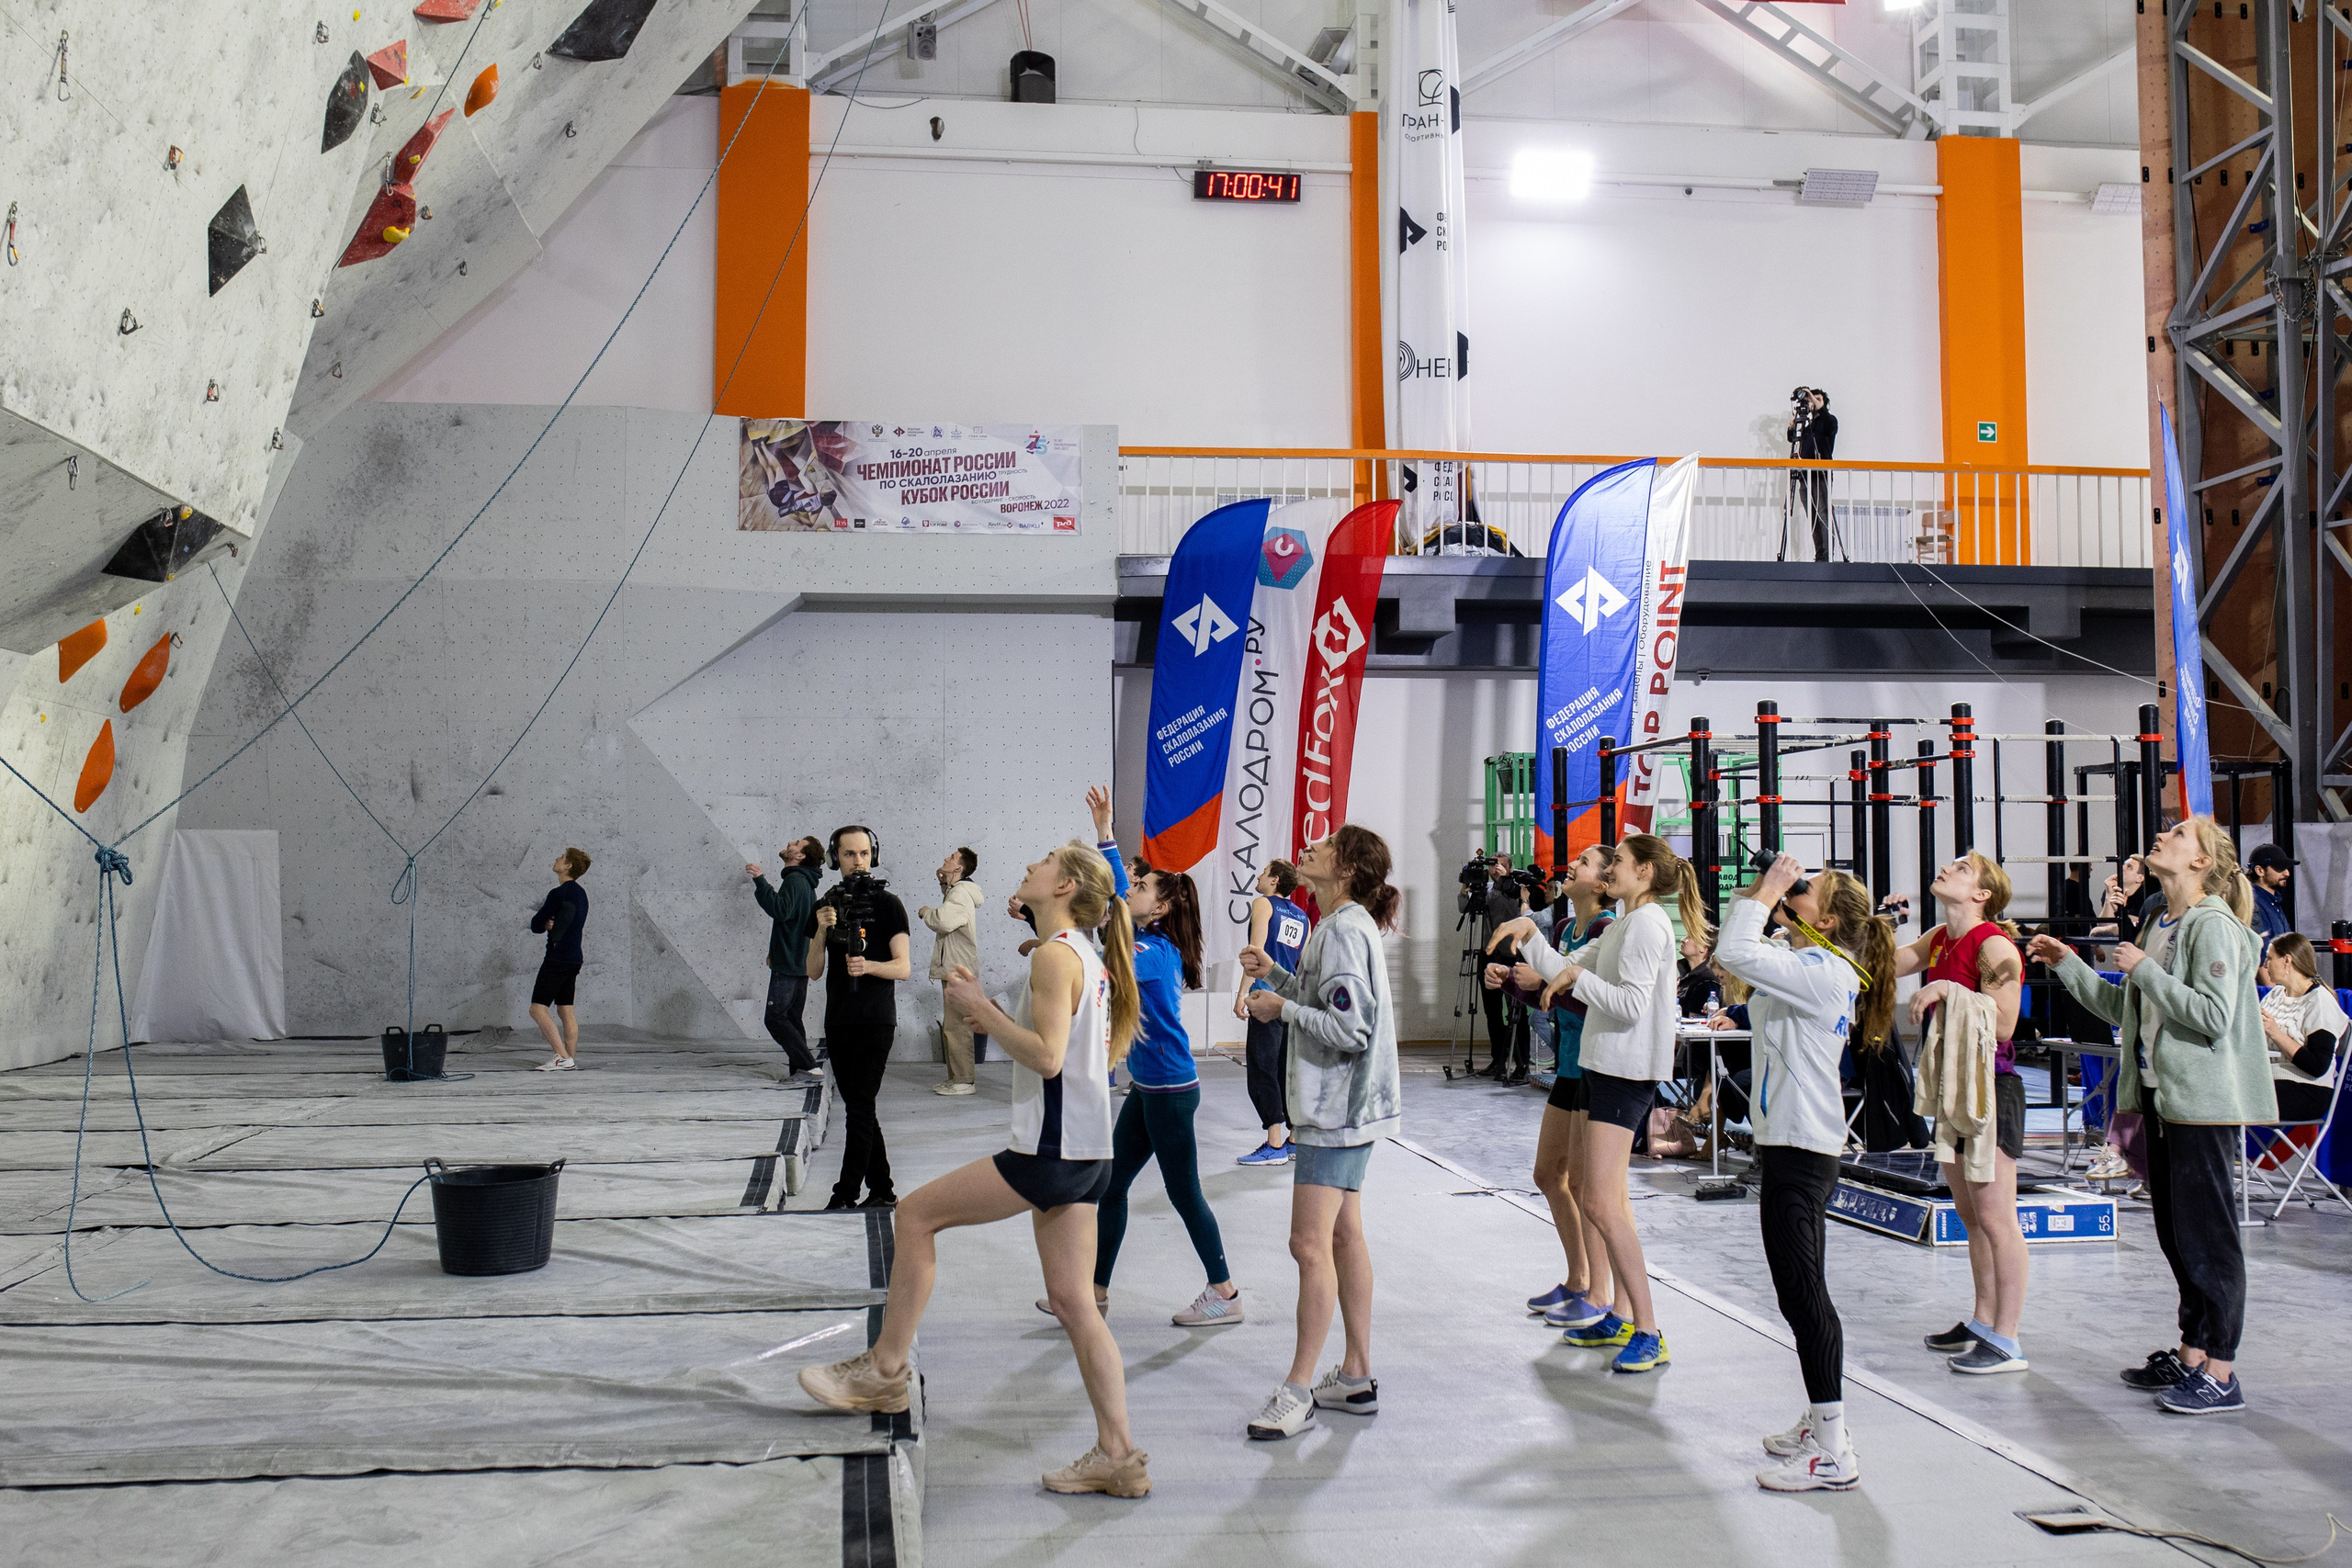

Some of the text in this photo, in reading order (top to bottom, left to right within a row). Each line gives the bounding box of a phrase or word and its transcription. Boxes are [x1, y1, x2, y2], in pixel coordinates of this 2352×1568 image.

[1208, 173, 1297, 199] 17:00:41
[856, 451, 1016, 481] ЧЕМПИОНАТ РОССИИ
[889, 447, 957, 459] 16-20 апреля
[879, 469, 998, 491] ПО СКАЛОЛАЗАНИЮ
[900, 481, 1011, 506] КУБОК РОССИИ
[1001, 498, 1069, 514] ВОРОНЕЖ 2022
[1638, 559, 1652, 650] Оборудование
[1634, 560, 1685, 796] TOP POINT
[1156, 705, 1206, 740] ФЕДЕРАЦИЯ
[1545, 686, 1600, 730] ФЕДЕРАЦИЯ
[1554, 688, 1624, 744] СКАЛОЛАЗАНИЯ
[1162, 707, 1228, 755] СКАЛОЛАЗАНИЯ
[1168, 739, 1204, 768] РОССИИ
[1284, 924, 1298, 940] 073
[1800, 923, 1841, 956] NAVIGATOR
[2098, 1214, 2110, 1232] 55
